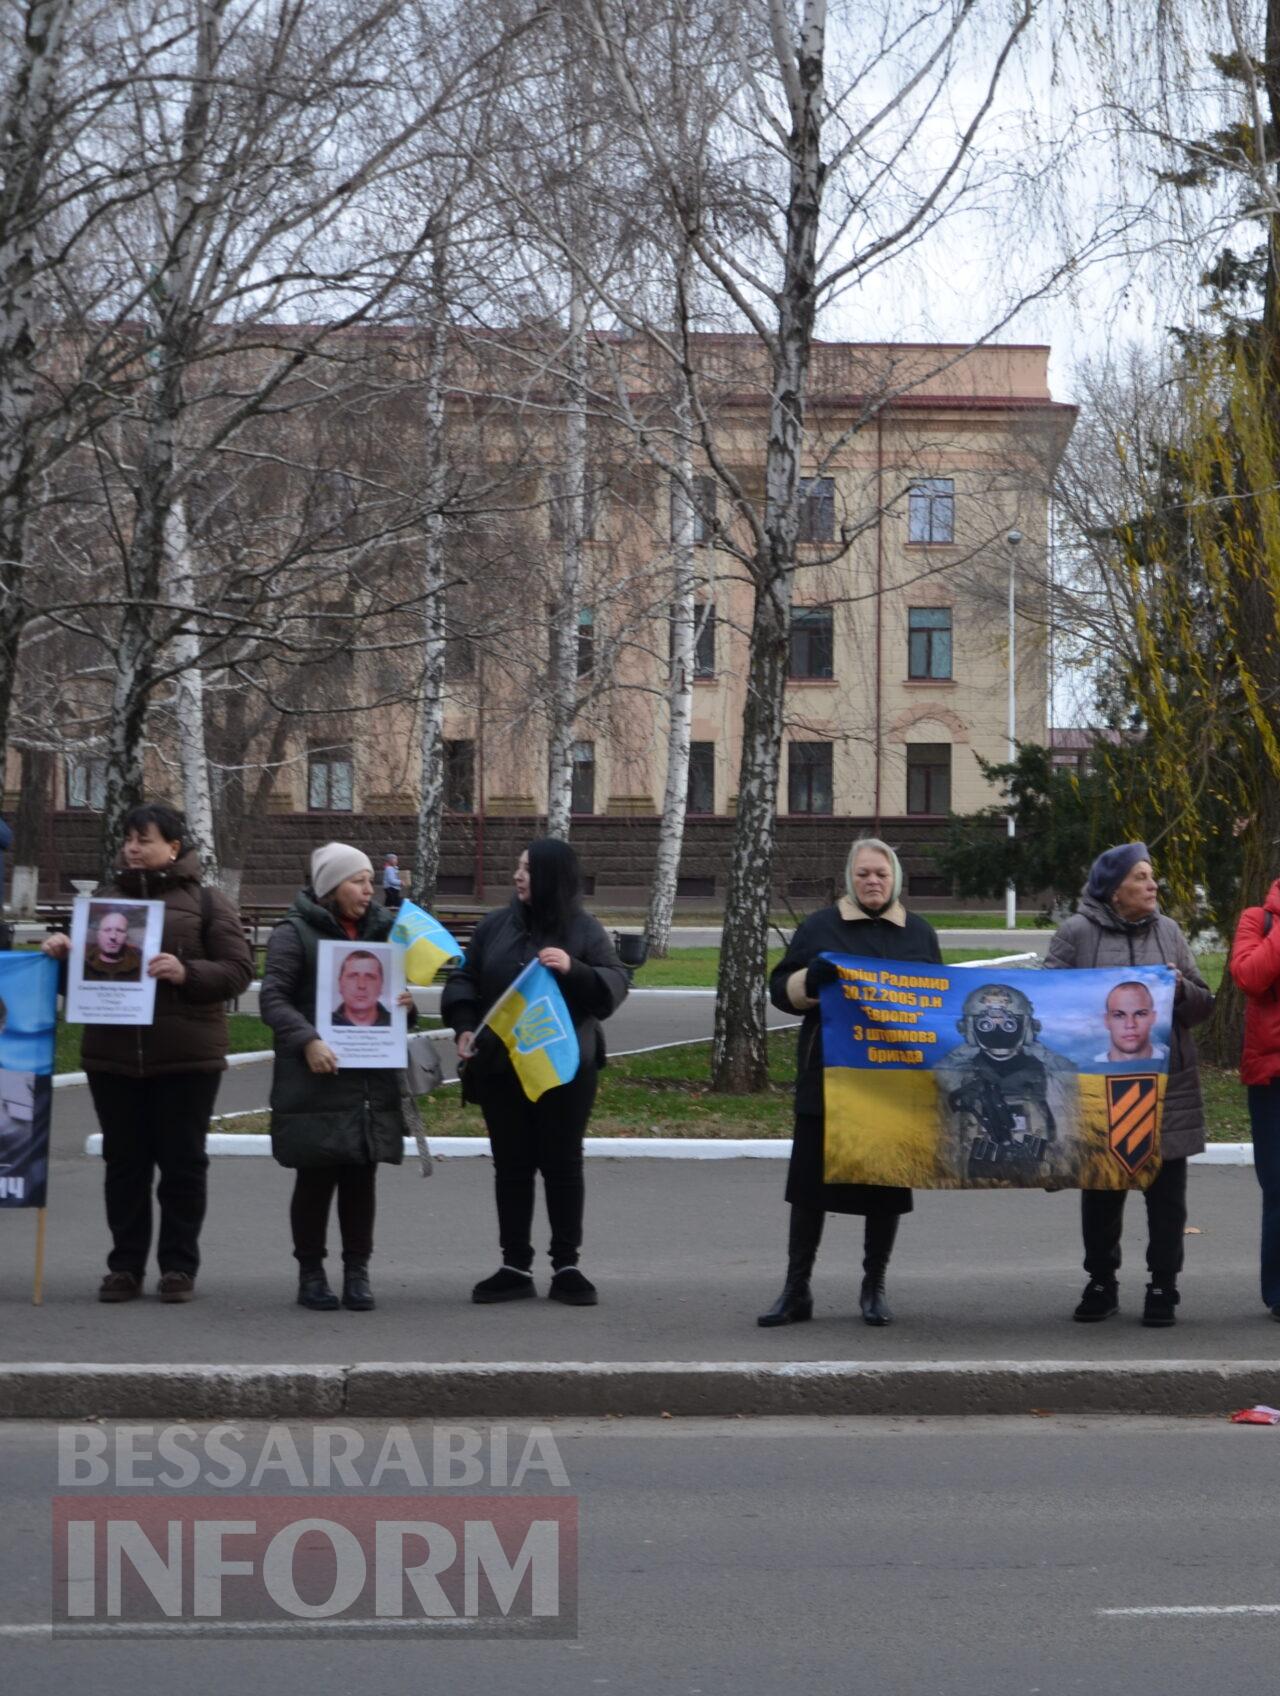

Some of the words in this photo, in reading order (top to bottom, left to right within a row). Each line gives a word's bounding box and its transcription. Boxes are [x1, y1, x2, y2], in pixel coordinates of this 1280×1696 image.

[880, 971, 950, 992] Радомир
[842, 984, 918, 1007] 30.12.2005
[853, 1025, 864, 1041] 3
